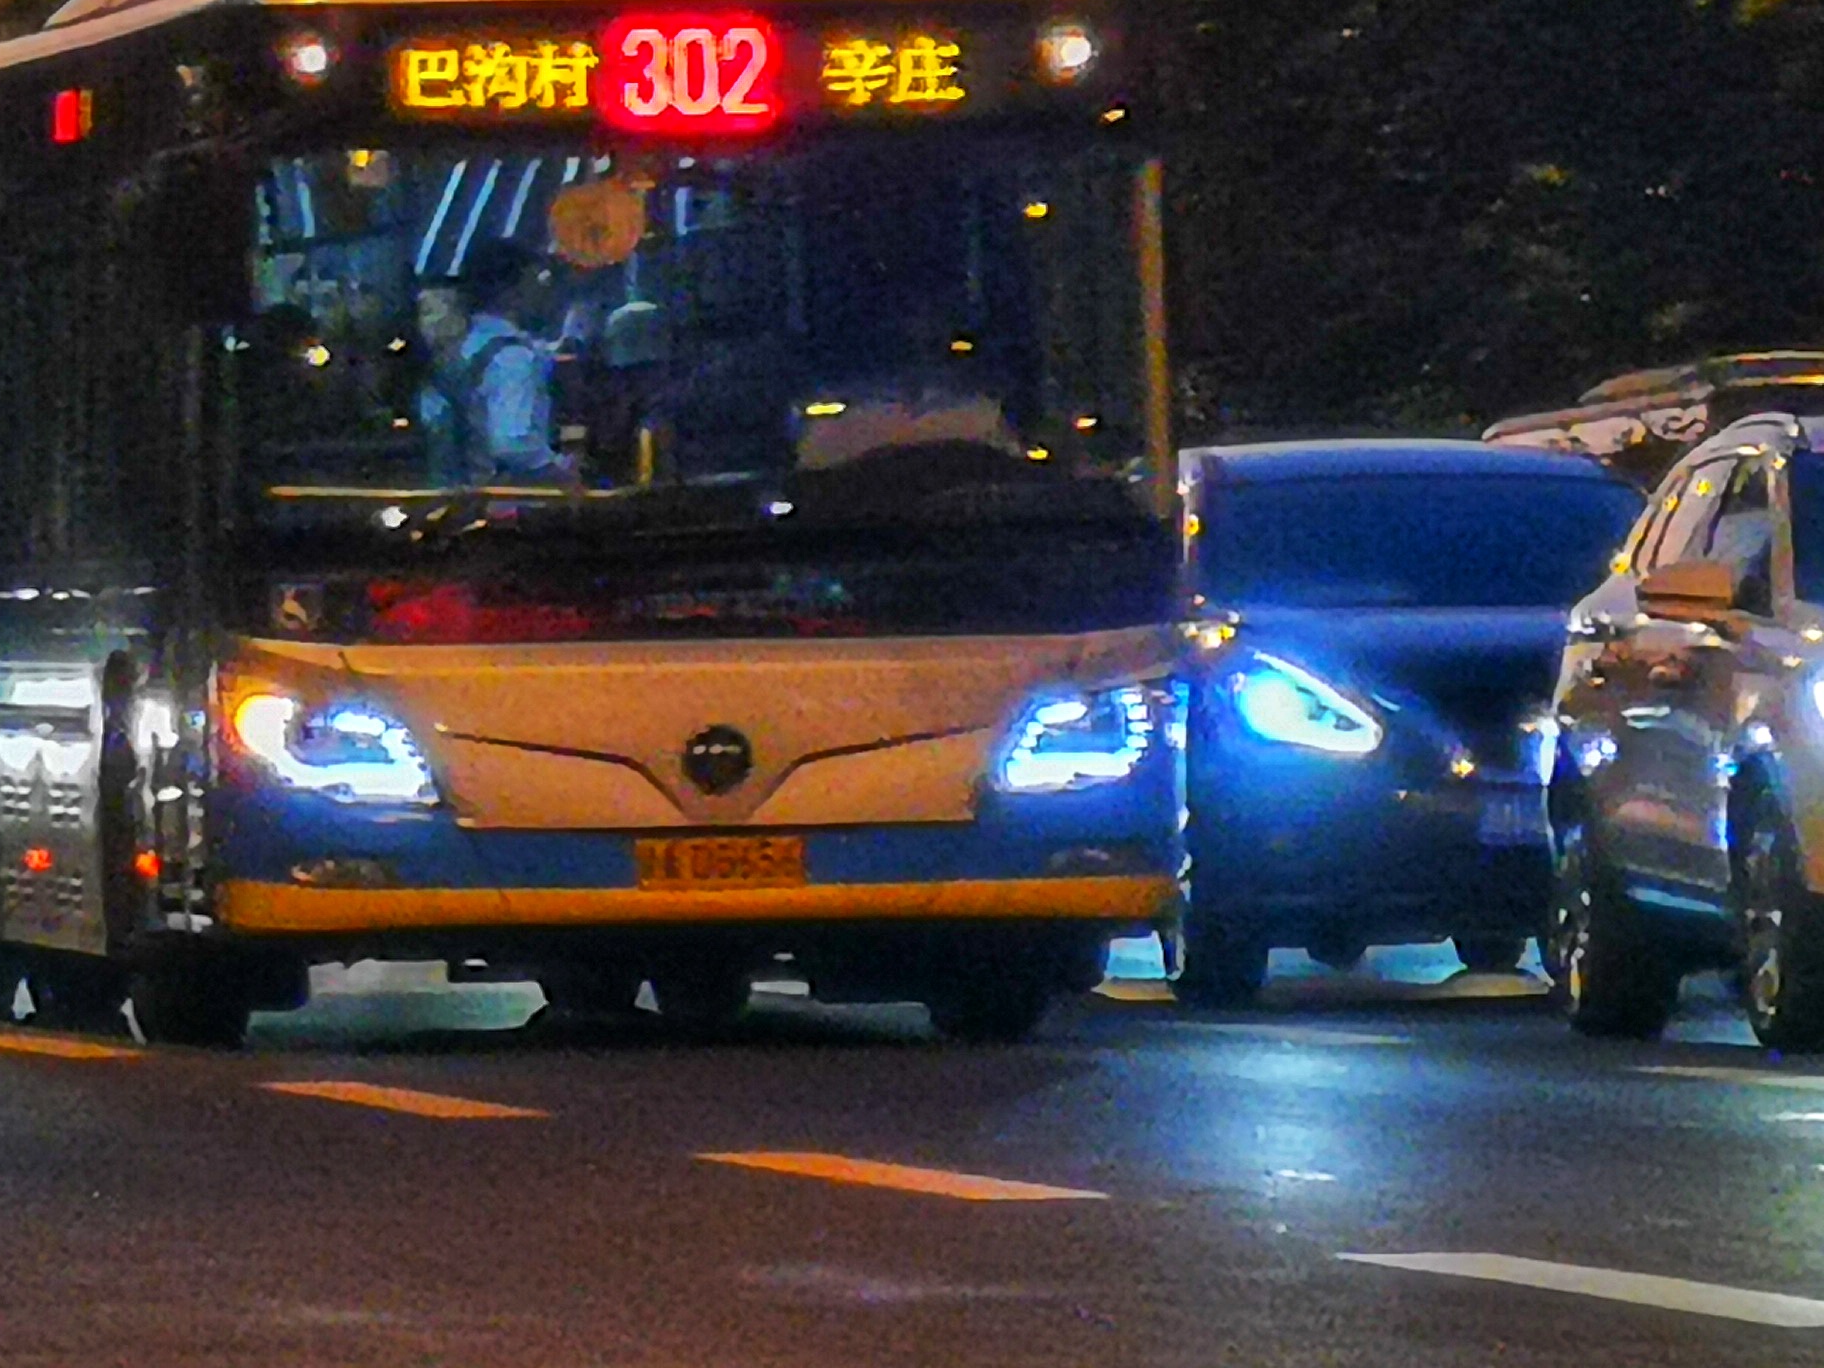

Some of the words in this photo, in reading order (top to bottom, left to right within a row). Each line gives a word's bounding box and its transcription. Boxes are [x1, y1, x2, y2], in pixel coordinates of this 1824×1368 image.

[403, 41, 599, 108] 巴沟村
[621, 27, 769, 116] 302
[822, 36, 966, 104] 辛庄
